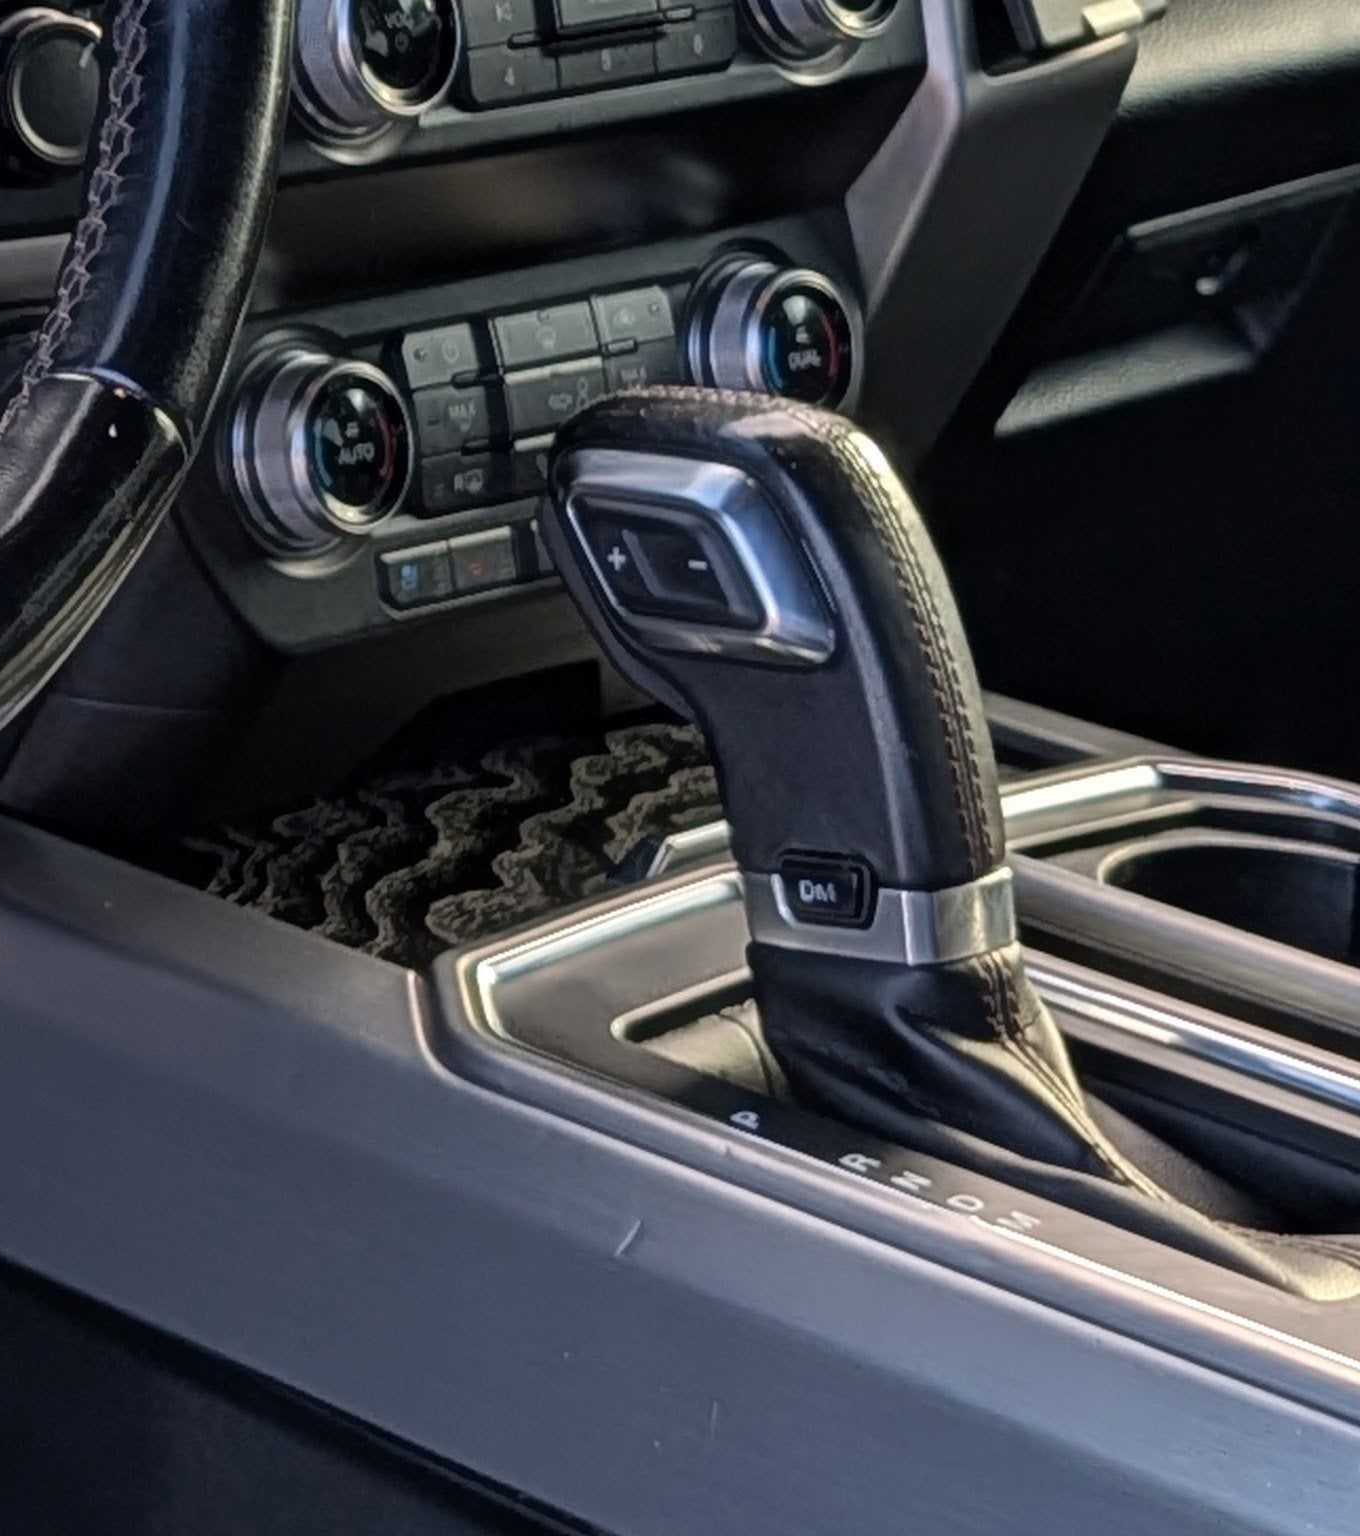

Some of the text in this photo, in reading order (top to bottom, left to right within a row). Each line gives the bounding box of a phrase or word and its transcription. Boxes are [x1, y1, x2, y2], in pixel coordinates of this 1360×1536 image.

[730, 1110, 760, 1131] P
[837, 1152, 881, 1173] R
[890, 1170, 932, 1192] N
[946, 1194, 985, 1213] D
